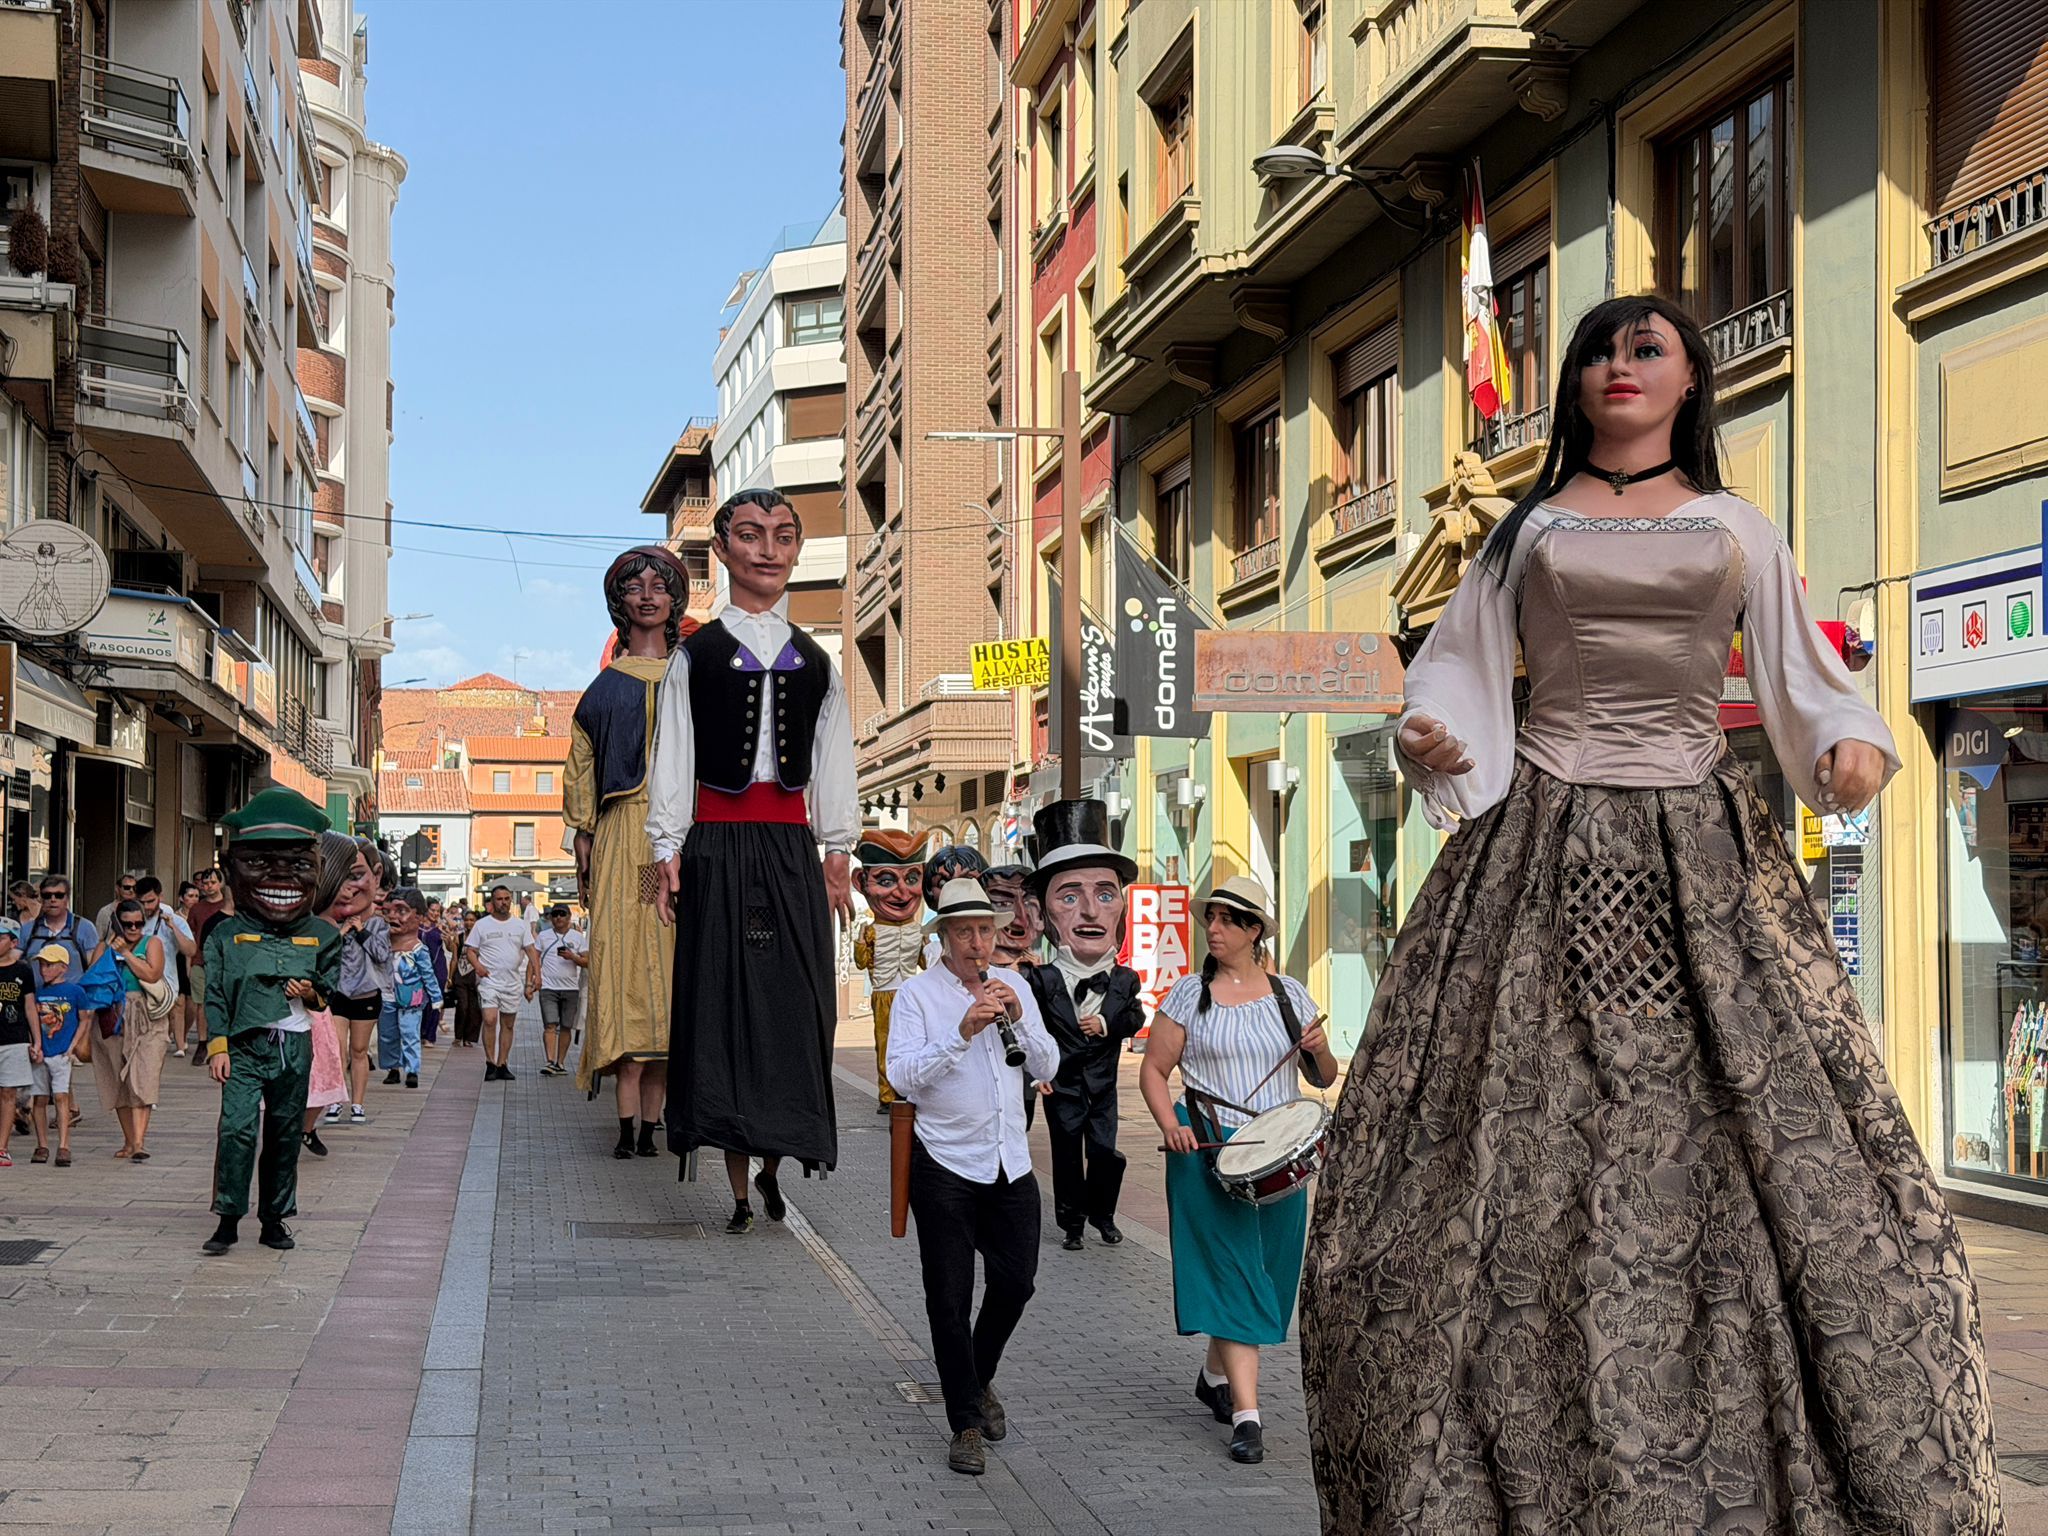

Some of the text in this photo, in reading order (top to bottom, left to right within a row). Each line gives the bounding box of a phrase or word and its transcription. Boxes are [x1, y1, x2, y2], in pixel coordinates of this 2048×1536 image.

[100, 643, 172, 657] ASOCIADOS
[1154, 596, 1177, 730] domani
[1099, 652, 1116, 699] grupo
[1224, 668, 1380, 694] domani
[1953, 729, 1989, 757] DIGI
